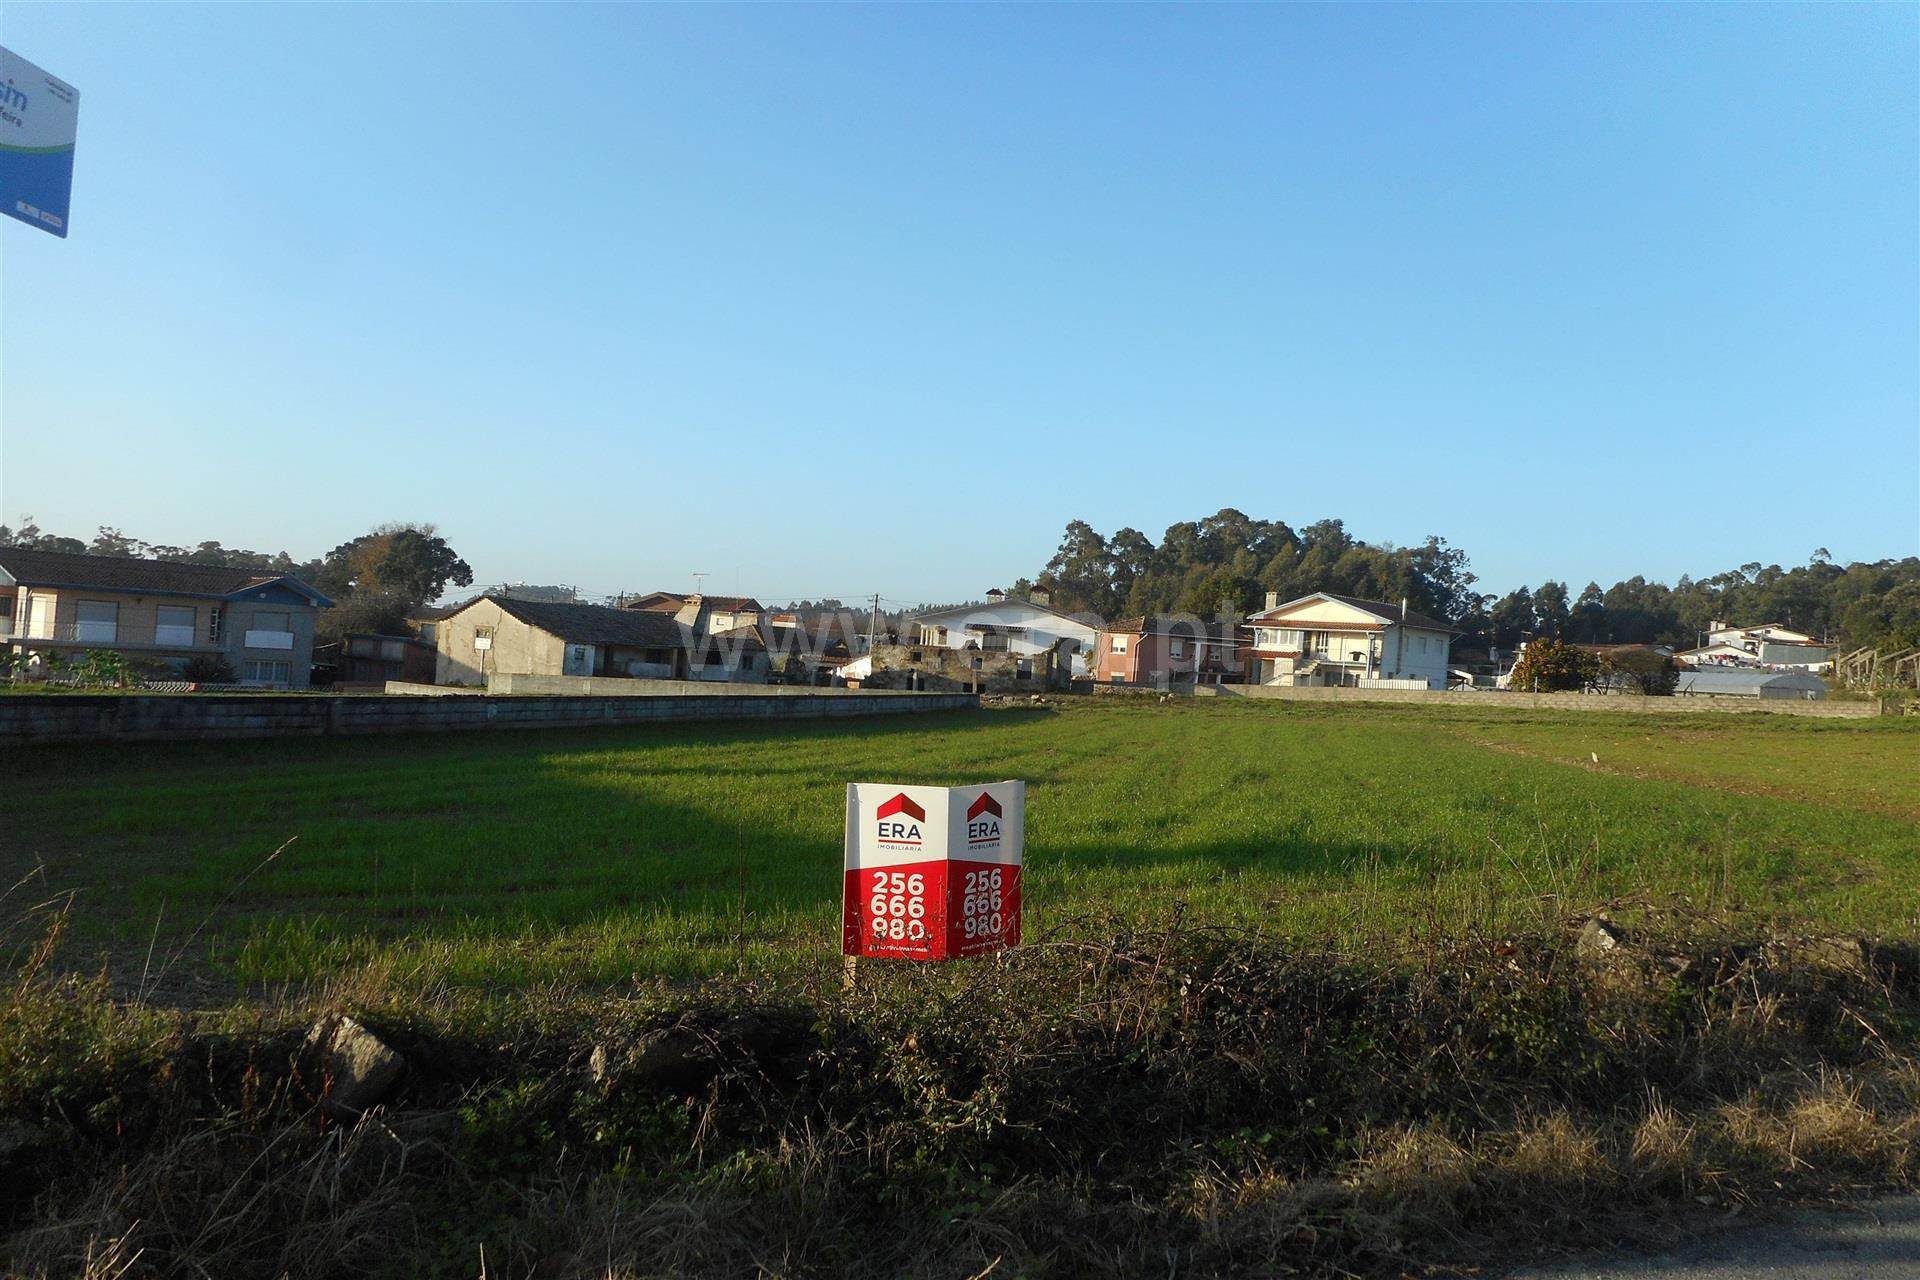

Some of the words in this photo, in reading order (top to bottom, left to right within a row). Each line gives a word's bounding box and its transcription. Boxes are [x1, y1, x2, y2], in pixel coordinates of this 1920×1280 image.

[878, 822, 922, 839] ERA
[968, 821, 1000, 839] ERA
[871, 871, 925, 896] 256
[964, 868, 1002, 895] 256
[870, 894, 925, 919] 666
[963, 890, 1002, 917] 666
[871, 917, 925, 941] 980
[964, 912, 1002, 939] 980
